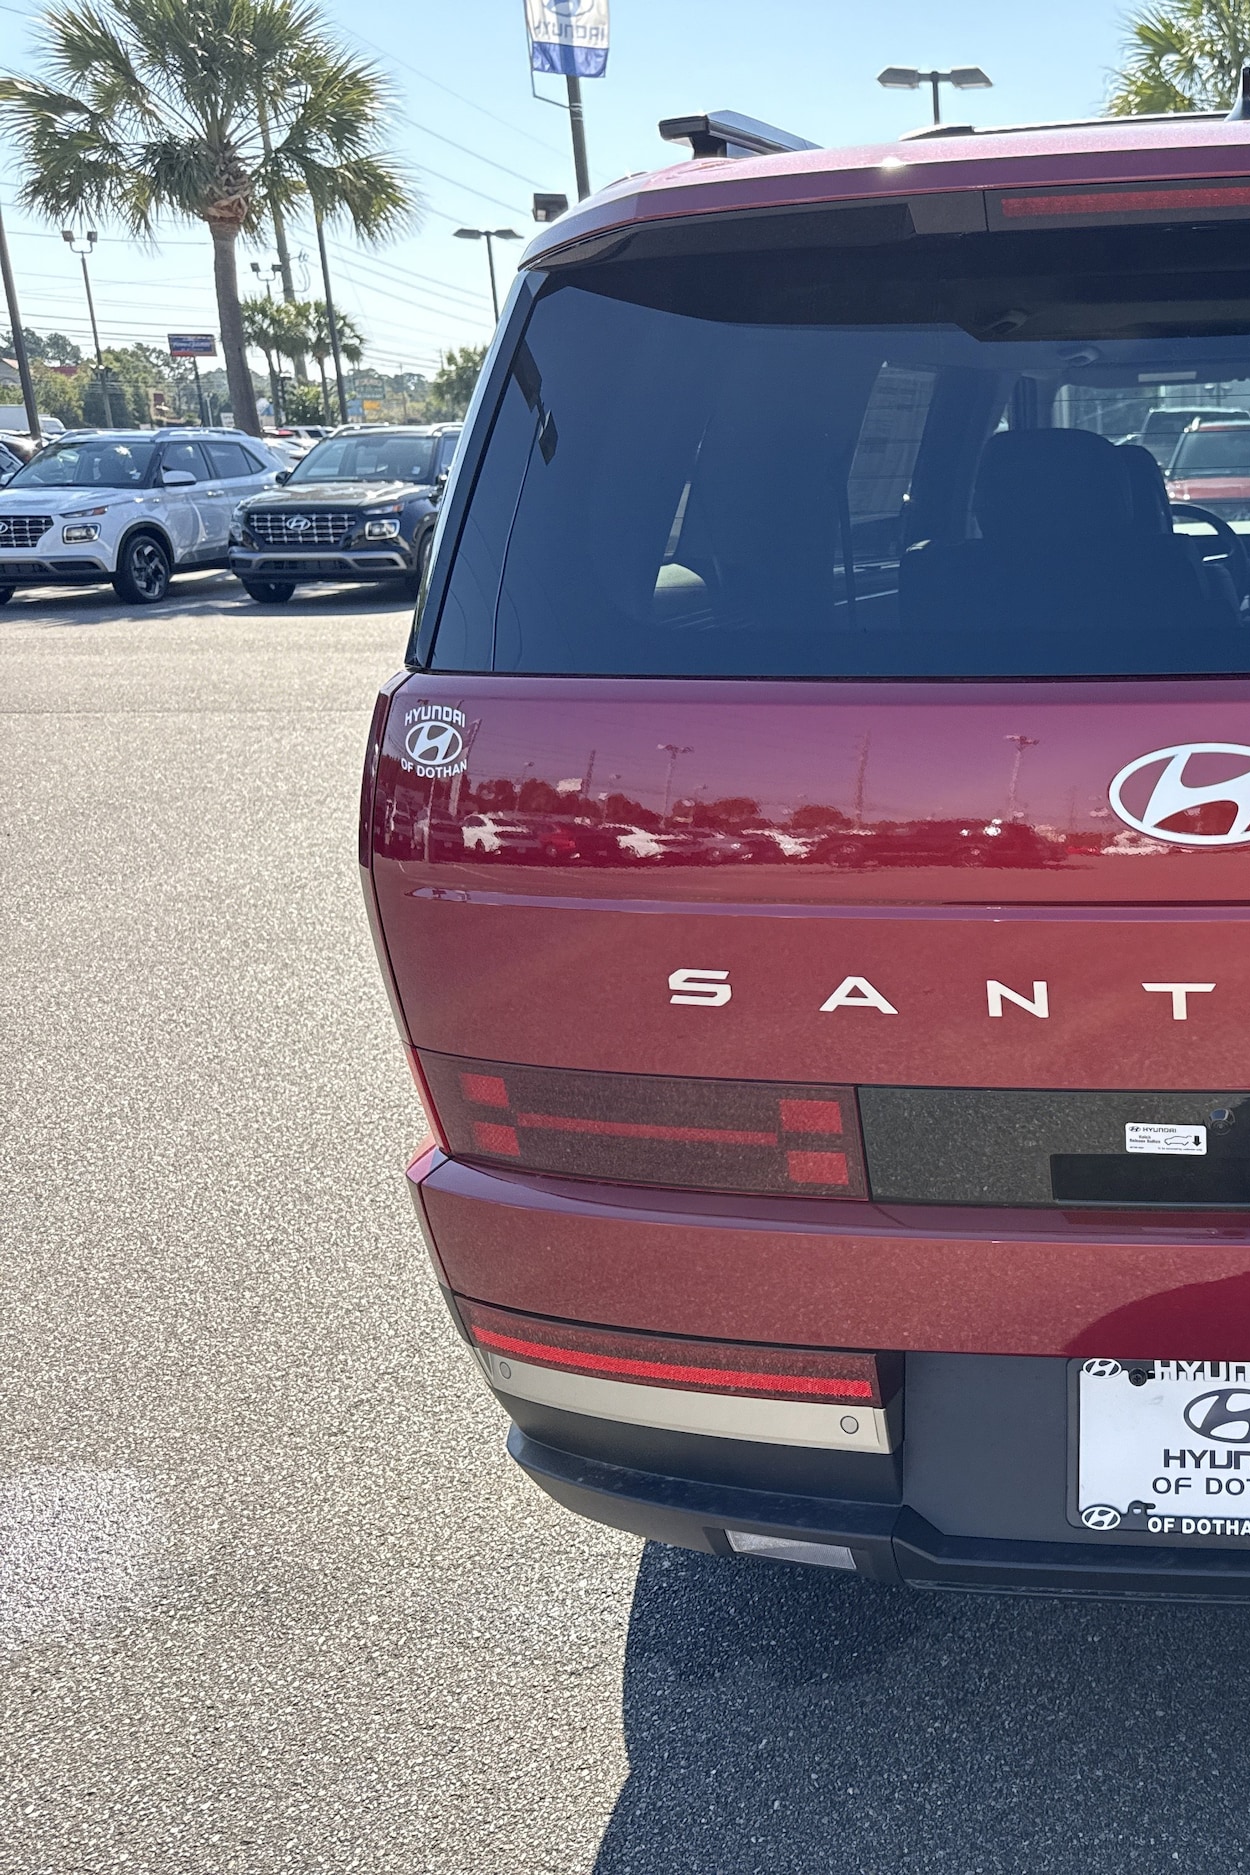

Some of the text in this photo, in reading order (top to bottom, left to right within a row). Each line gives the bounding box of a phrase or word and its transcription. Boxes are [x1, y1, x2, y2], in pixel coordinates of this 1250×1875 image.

[404, 705, 466, 728] HYUNDAI
[401, 758, 467, 778] OF DOTHAN
[1152, 1477, 1192, 1495] OF
[1147, 1516, 1177, 1534] OF
